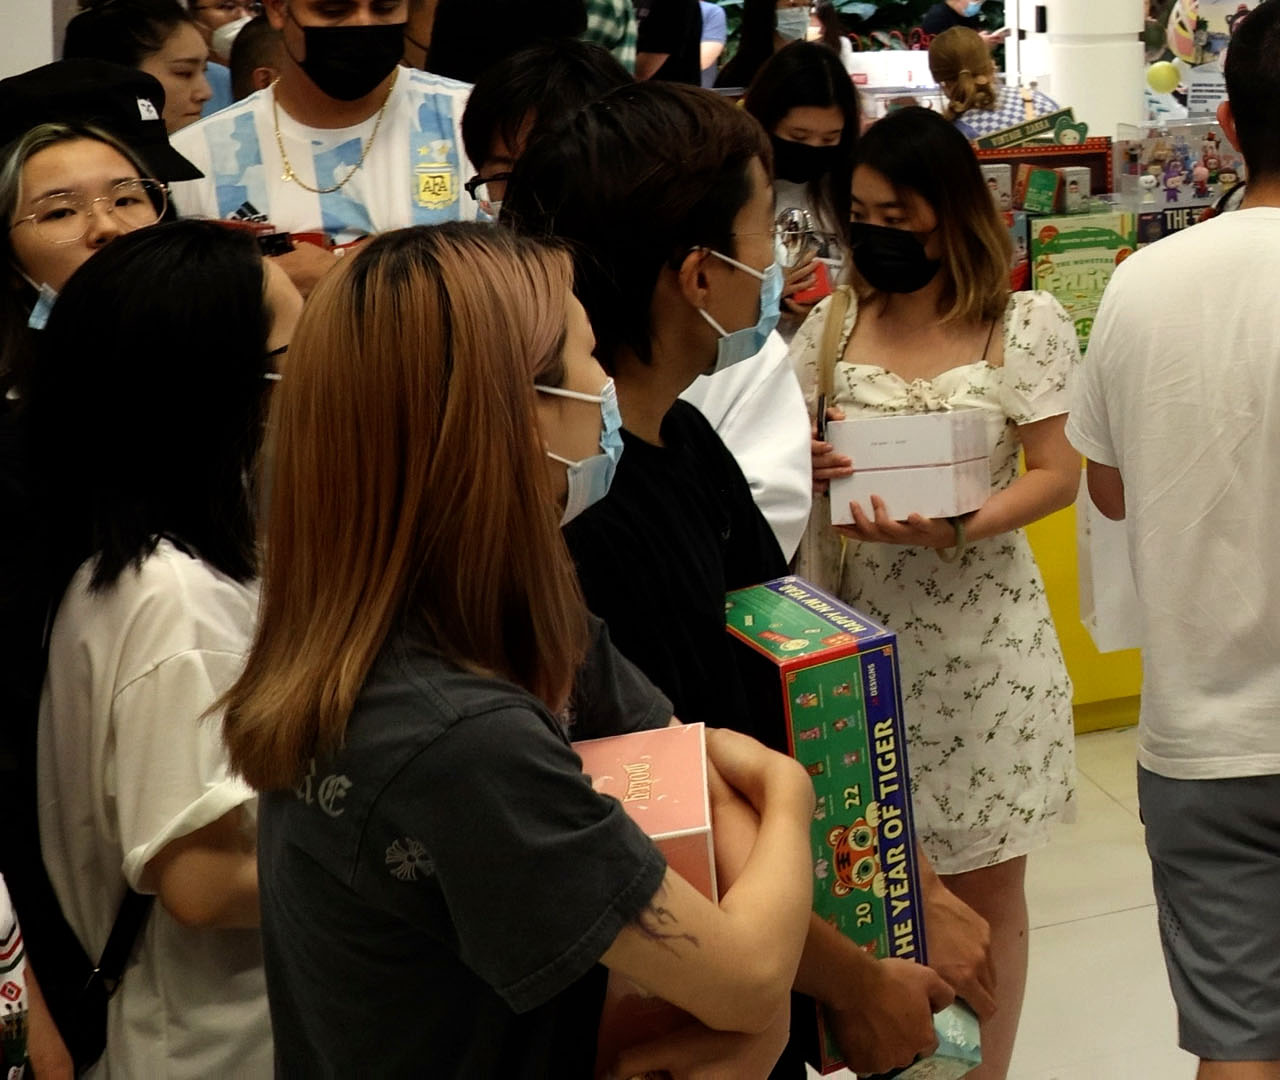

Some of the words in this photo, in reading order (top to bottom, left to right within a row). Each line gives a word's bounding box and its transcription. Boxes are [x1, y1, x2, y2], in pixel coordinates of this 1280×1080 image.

[1164, 209, 1190, 230] THE
[874, 717, 900, 800] TIGER
[844, 784, 861, 811] 22
[882, 804, 904, 840] OF
[886, 842, 910, 917] YEAR
[856, 902, 873, 928] 20
[893, 919, 916, 962] HE
